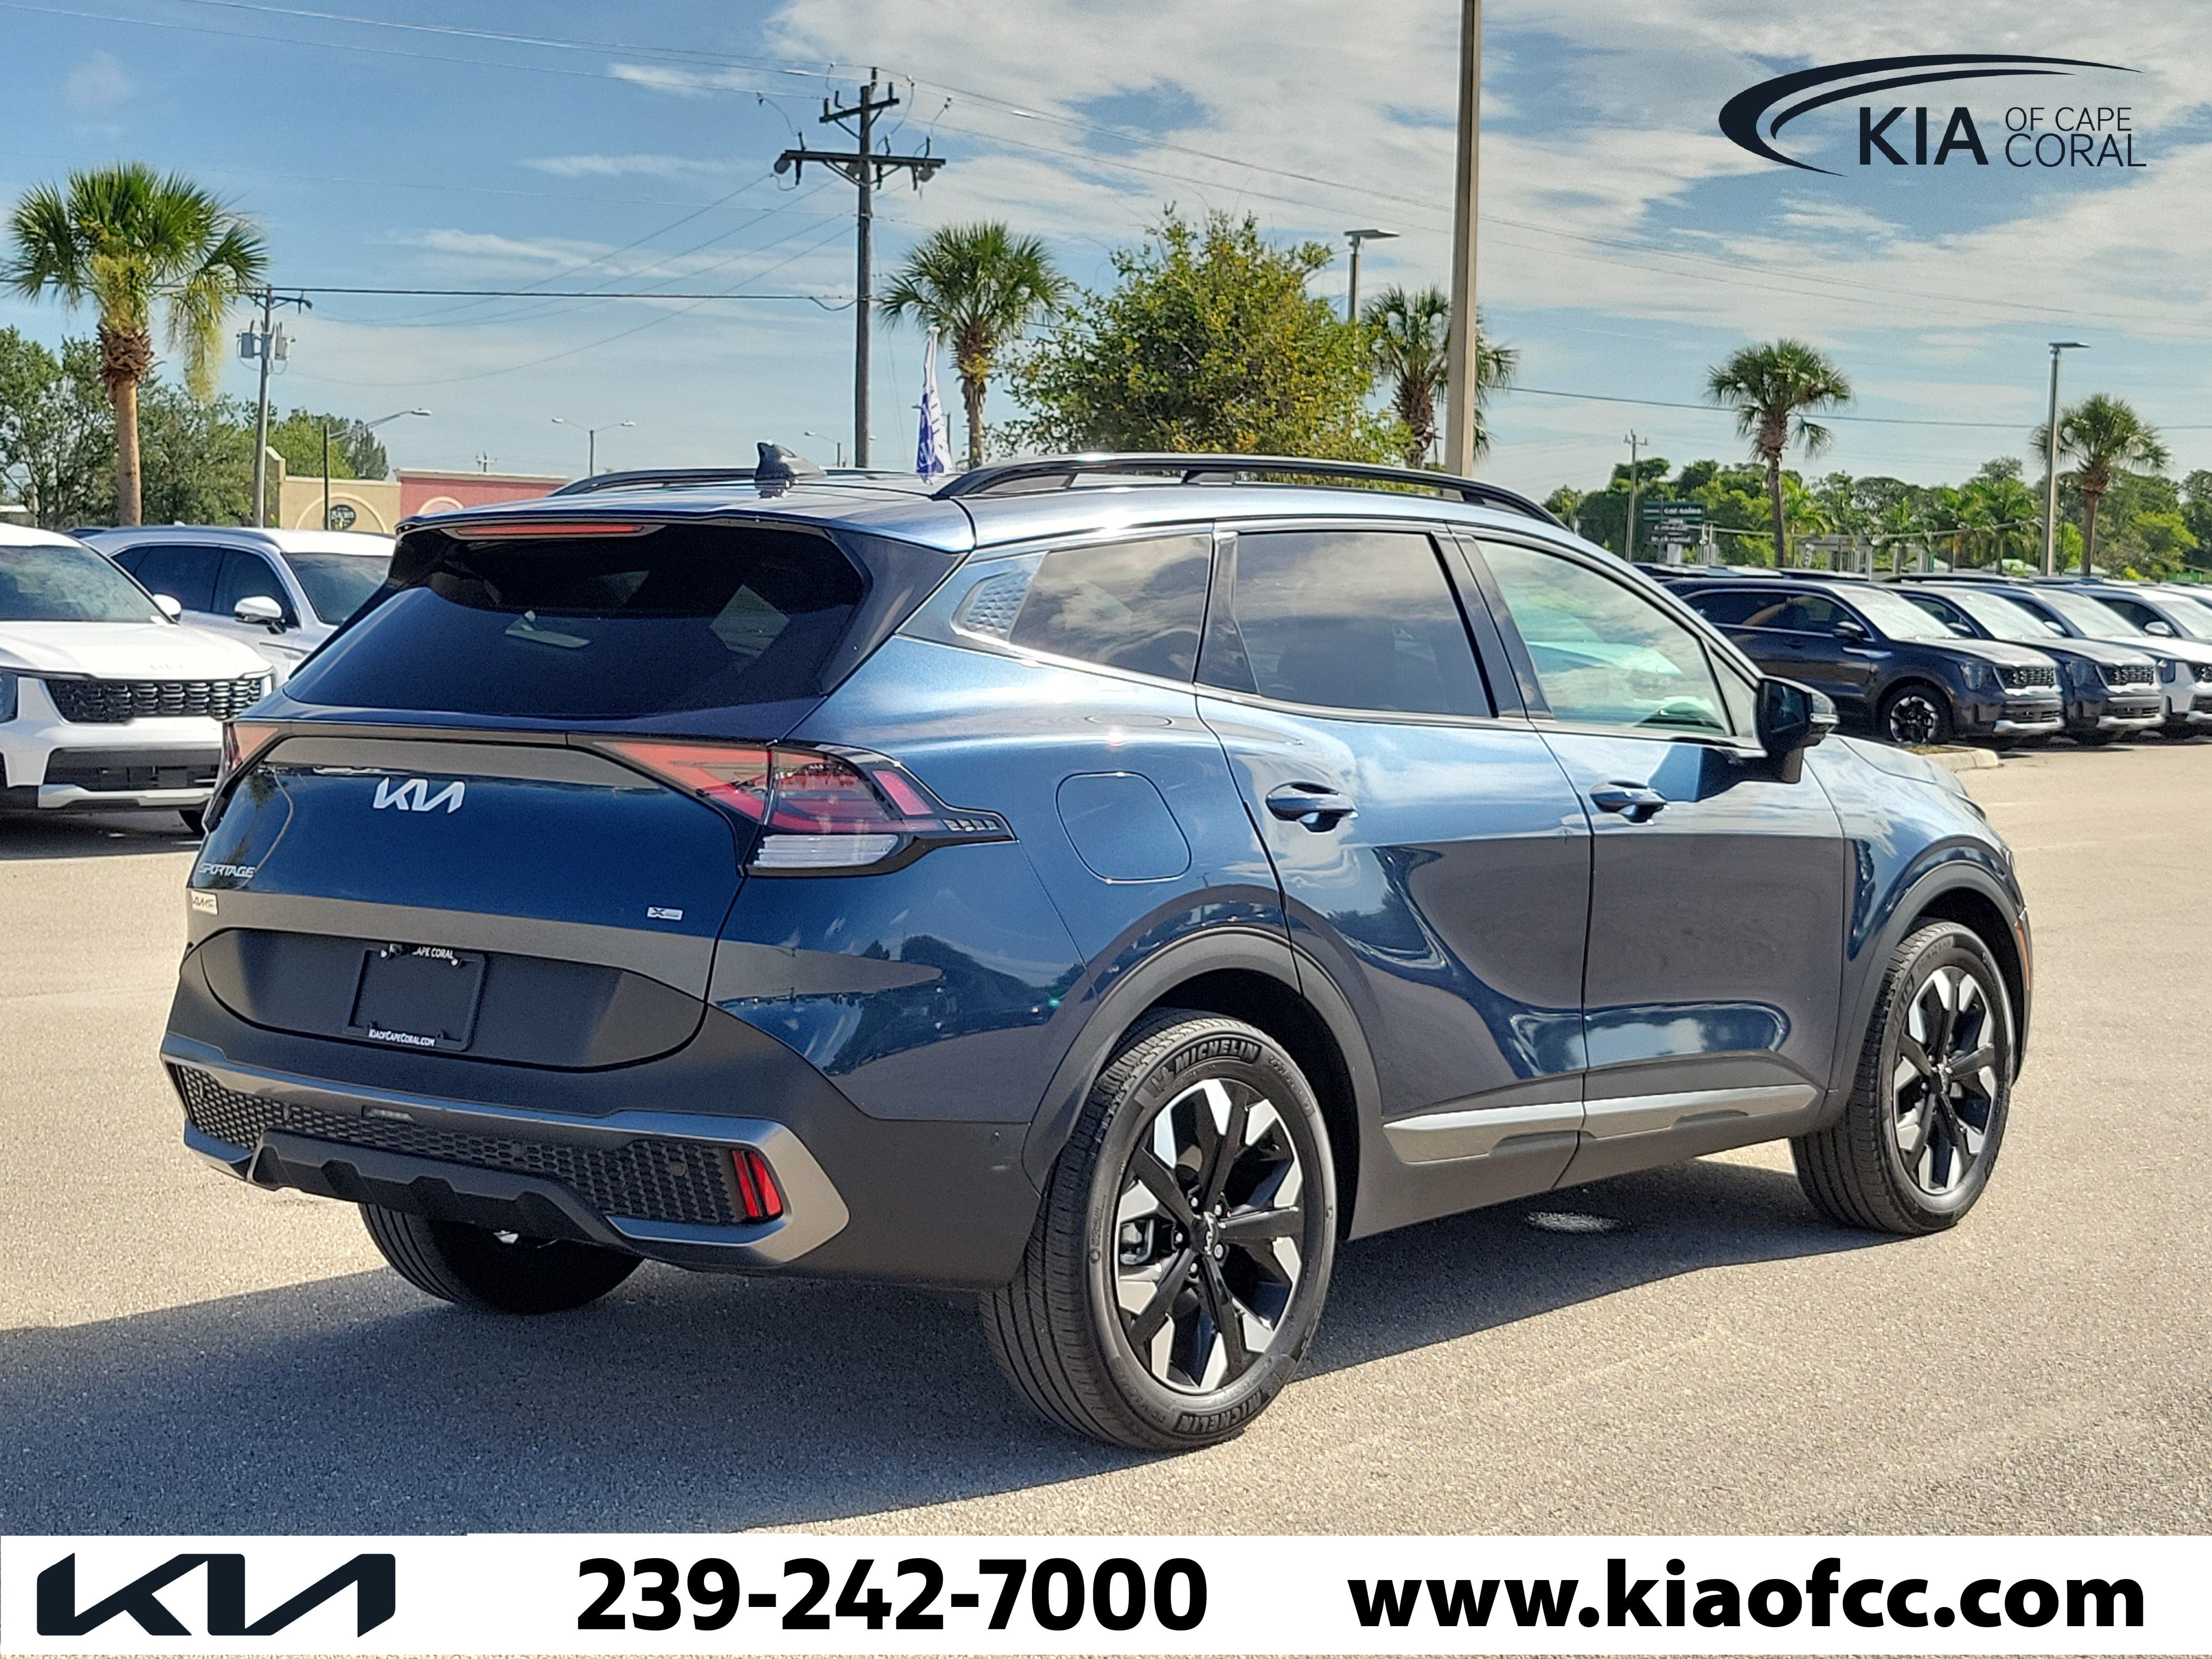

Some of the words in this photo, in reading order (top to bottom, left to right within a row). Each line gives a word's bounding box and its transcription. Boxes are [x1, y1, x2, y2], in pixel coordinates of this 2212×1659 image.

[373, 777, 465, 813] KIA
[199, 862, 256, 878] SPORTAGE
[431, 947, 454, 959] CORAL
[1175, 1040, 1260, 1074] MICHELIN
[1180, 1389, 1263, 1434] MICHELIN
